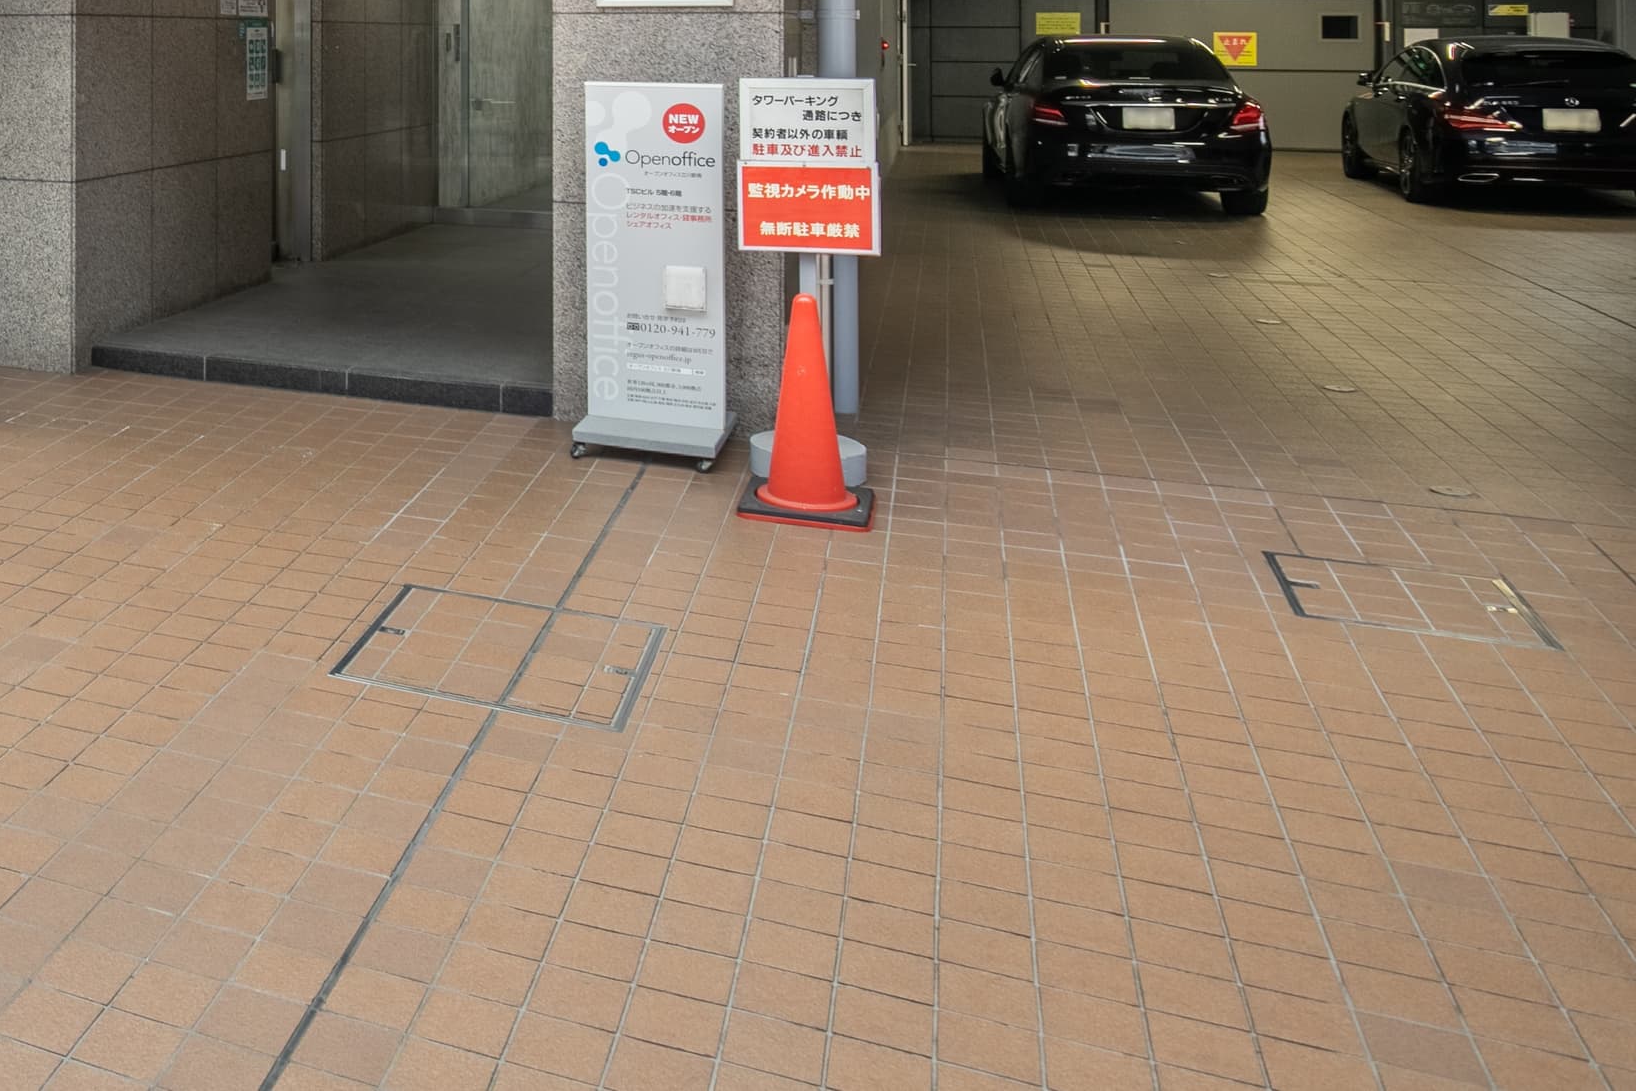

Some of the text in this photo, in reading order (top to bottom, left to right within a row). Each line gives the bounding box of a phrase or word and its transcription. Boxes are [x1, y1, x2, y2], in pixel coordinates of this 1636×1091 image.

[668, 113, 699, 125] NEW
[802, 110, 862, 122] 通路につき
[668, 125, 700, 134] オープン
[625, 149, 716, 168] Openoffice
[752, 143, 863, 158] 駐車及び進入禁止
[748, 183, 871, 201] 監視カメラ作動中
[759, 221, 860, 239] 無断駐車厳禁
[591, 172, 633, 401] Openoffice
